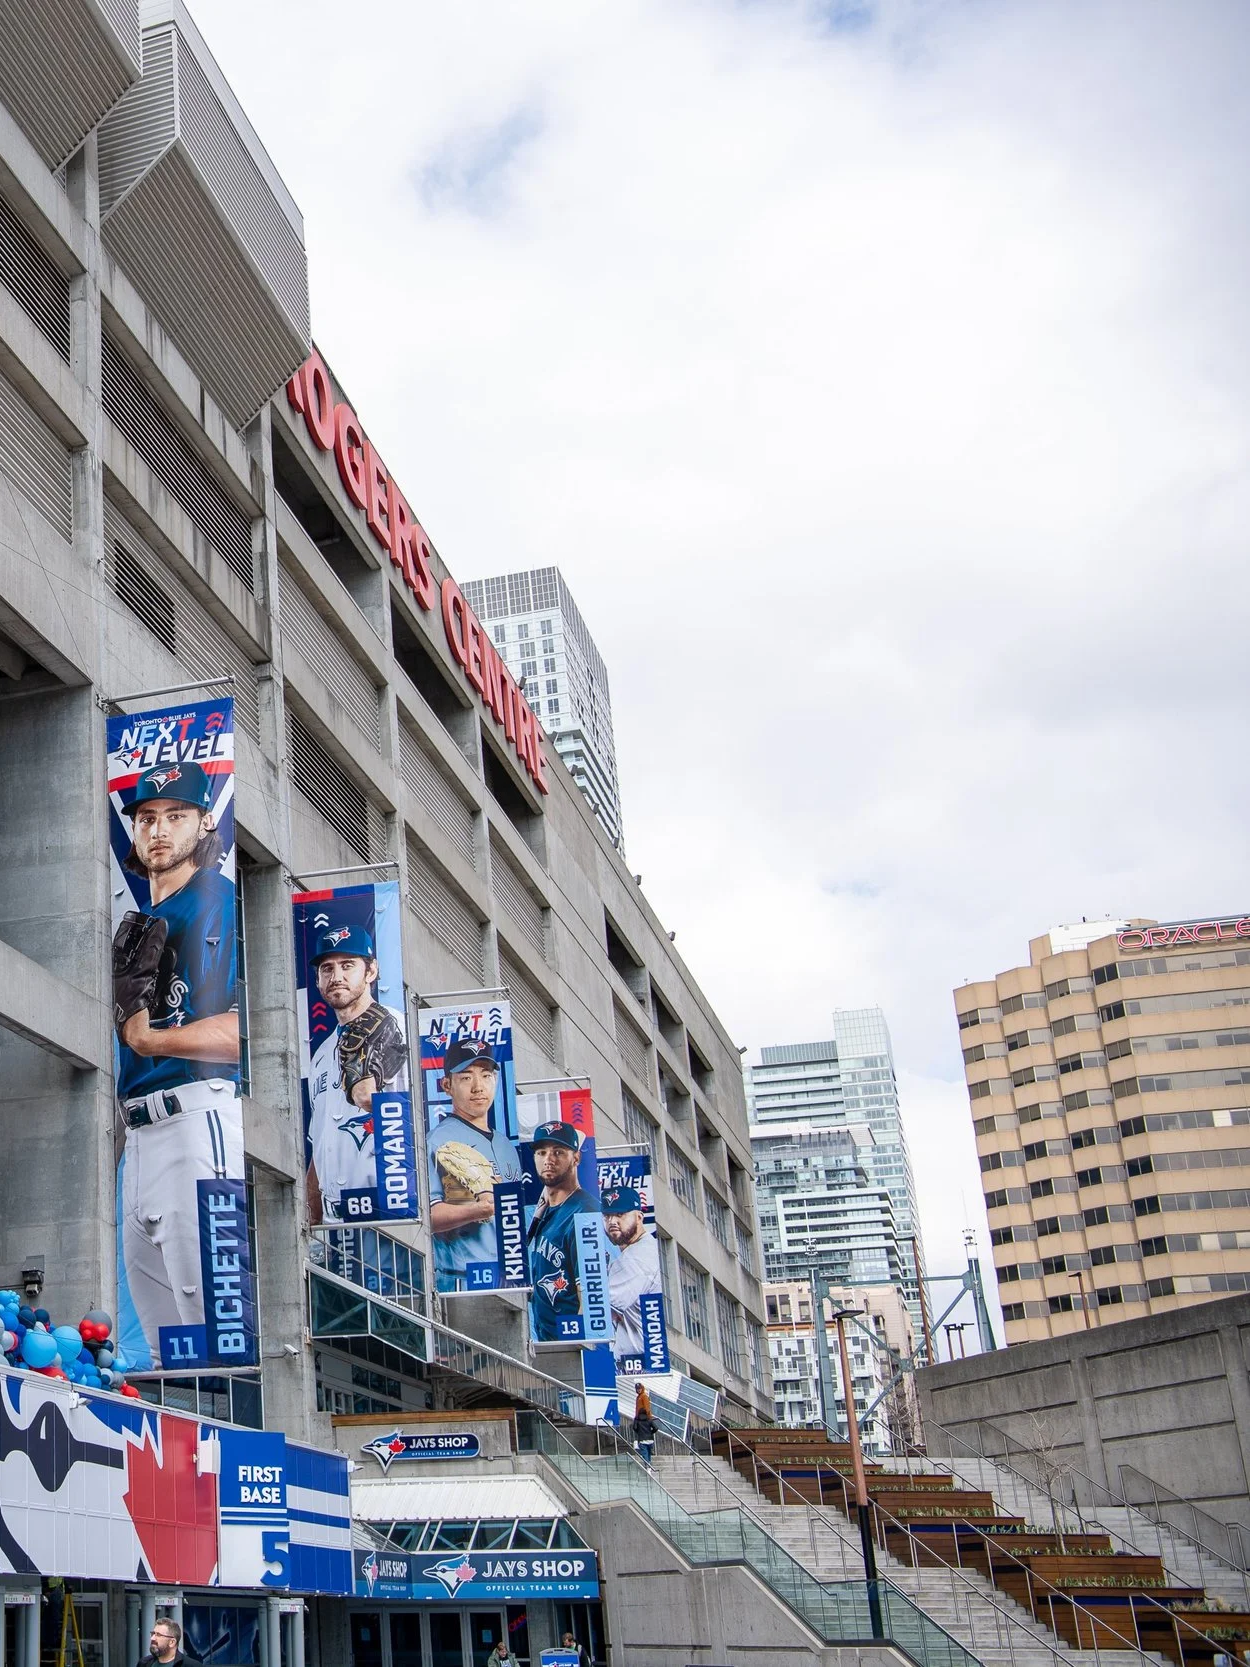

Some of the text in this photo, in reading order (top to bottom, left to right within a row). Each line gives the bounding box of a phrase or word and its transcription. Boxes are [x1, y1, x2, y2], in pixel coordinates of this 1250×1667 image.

[287, 347, 550, 796] OGERS CENTRE
[134, 717, 163, 727] TORONTO
[168, 714, 182, 722] BLUE
[120, 718, 196, 749] NEXT
[138, 734, 225, 769] LEVEL
[430, 1014, 483, 1036] NEXT
[380, 1101, 410, 1210] ROMANO
[597, 1164, 630, 1179] EXT
[347, 1196, 373, 1215] 68
[501, 1193, 524, 1280] KIKUCHI
[536, 1235, 565, 1268] AYS
[208, 1193, 246, 1354] BICHETTE
[472, 1268, 493, 1285] 16
[582, 1221, 607, 1331] GURRIEL JR.
[561, 1320, 580, 1336] 13
[644, 1299, 666, 1369] MANOAH
[168, 1336, 199, 1360] 11
[625, 1359, 642, 1371] 06
[604, 1398, 620, 1427] 4
[409, 1436, 469, 1449] JAYS SHOP
[238, 1465, 283, 1484] FIRST
[240, 1486, 281, 1505] BASE
[260, 1531, 290, 1587] 5
[379, 1559, 408, 1578] JAYS SHOP
[482, 1559, 585, 1578] JAYS SHOP
